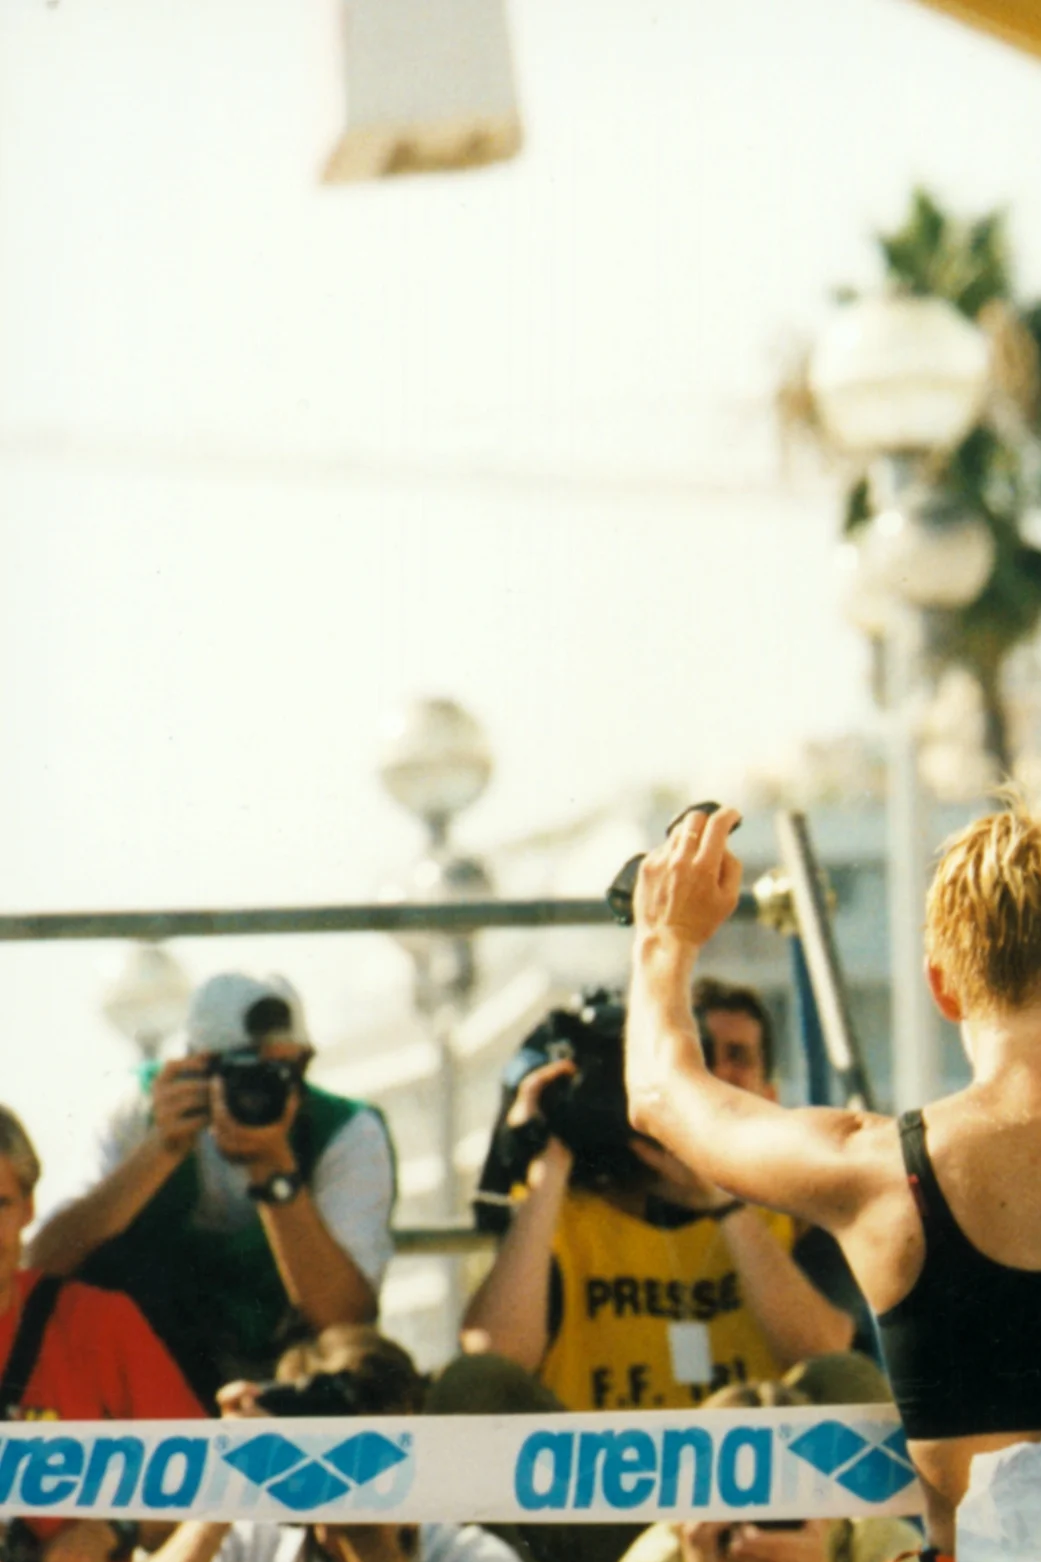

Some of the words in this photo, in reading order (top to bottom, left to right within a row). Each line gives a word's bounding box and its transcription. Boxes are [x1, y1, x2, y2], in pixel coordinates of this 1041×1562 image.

[585, 1272, 743, 1322] PRESSE
[0, 1435, 210, 1509] rena
[514, 1426, 773, 1511] arena
